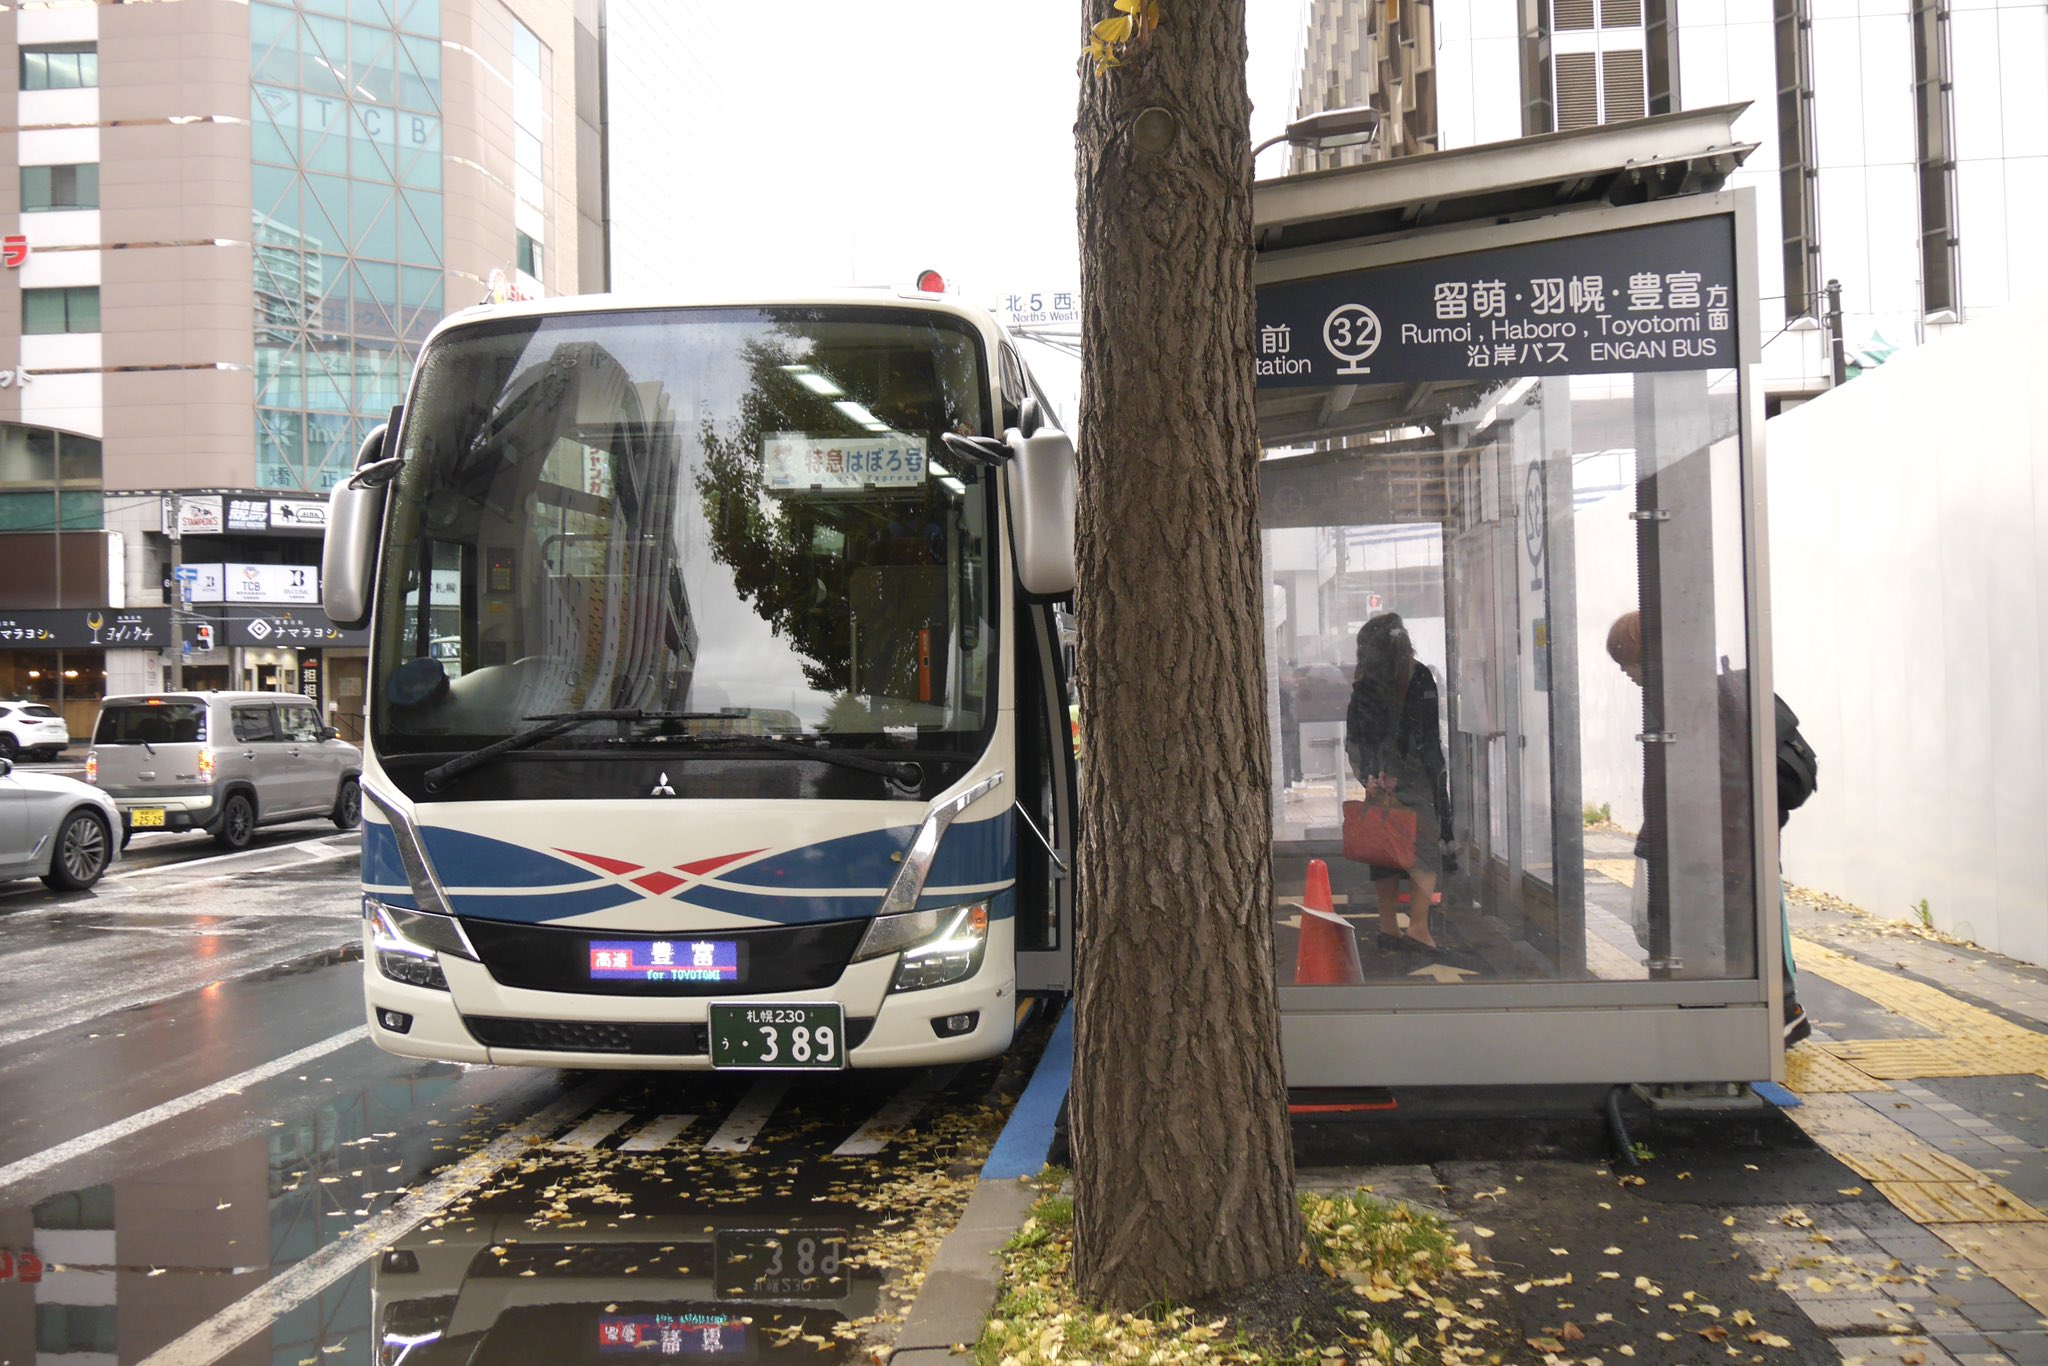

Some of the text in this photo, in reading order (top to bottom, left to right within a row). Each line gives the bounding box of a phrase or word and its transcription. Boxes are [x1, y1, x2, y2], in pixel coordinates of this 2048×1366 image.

[315, 98, 426, 144] TCB
[1434, 270, 1729, 331] 留萌・羽幌・豊富 方面
[1333, 316, 1375, 347] 32
[1596, 312, 1701, 336] Toyotomi
[1256, 323, 1291, 354] 前
[1467, 337, 1717, 367] 沿岸バス ENGAN BUS
[1255, 356, 1312, 375] tation
[805, 447, 923, 473] 特急はぼろ号
[243, 582, 261, 591] TCB
[671, 970, 720, 980] TOYOTOMI
[722, 1037, 729, 1050] う
